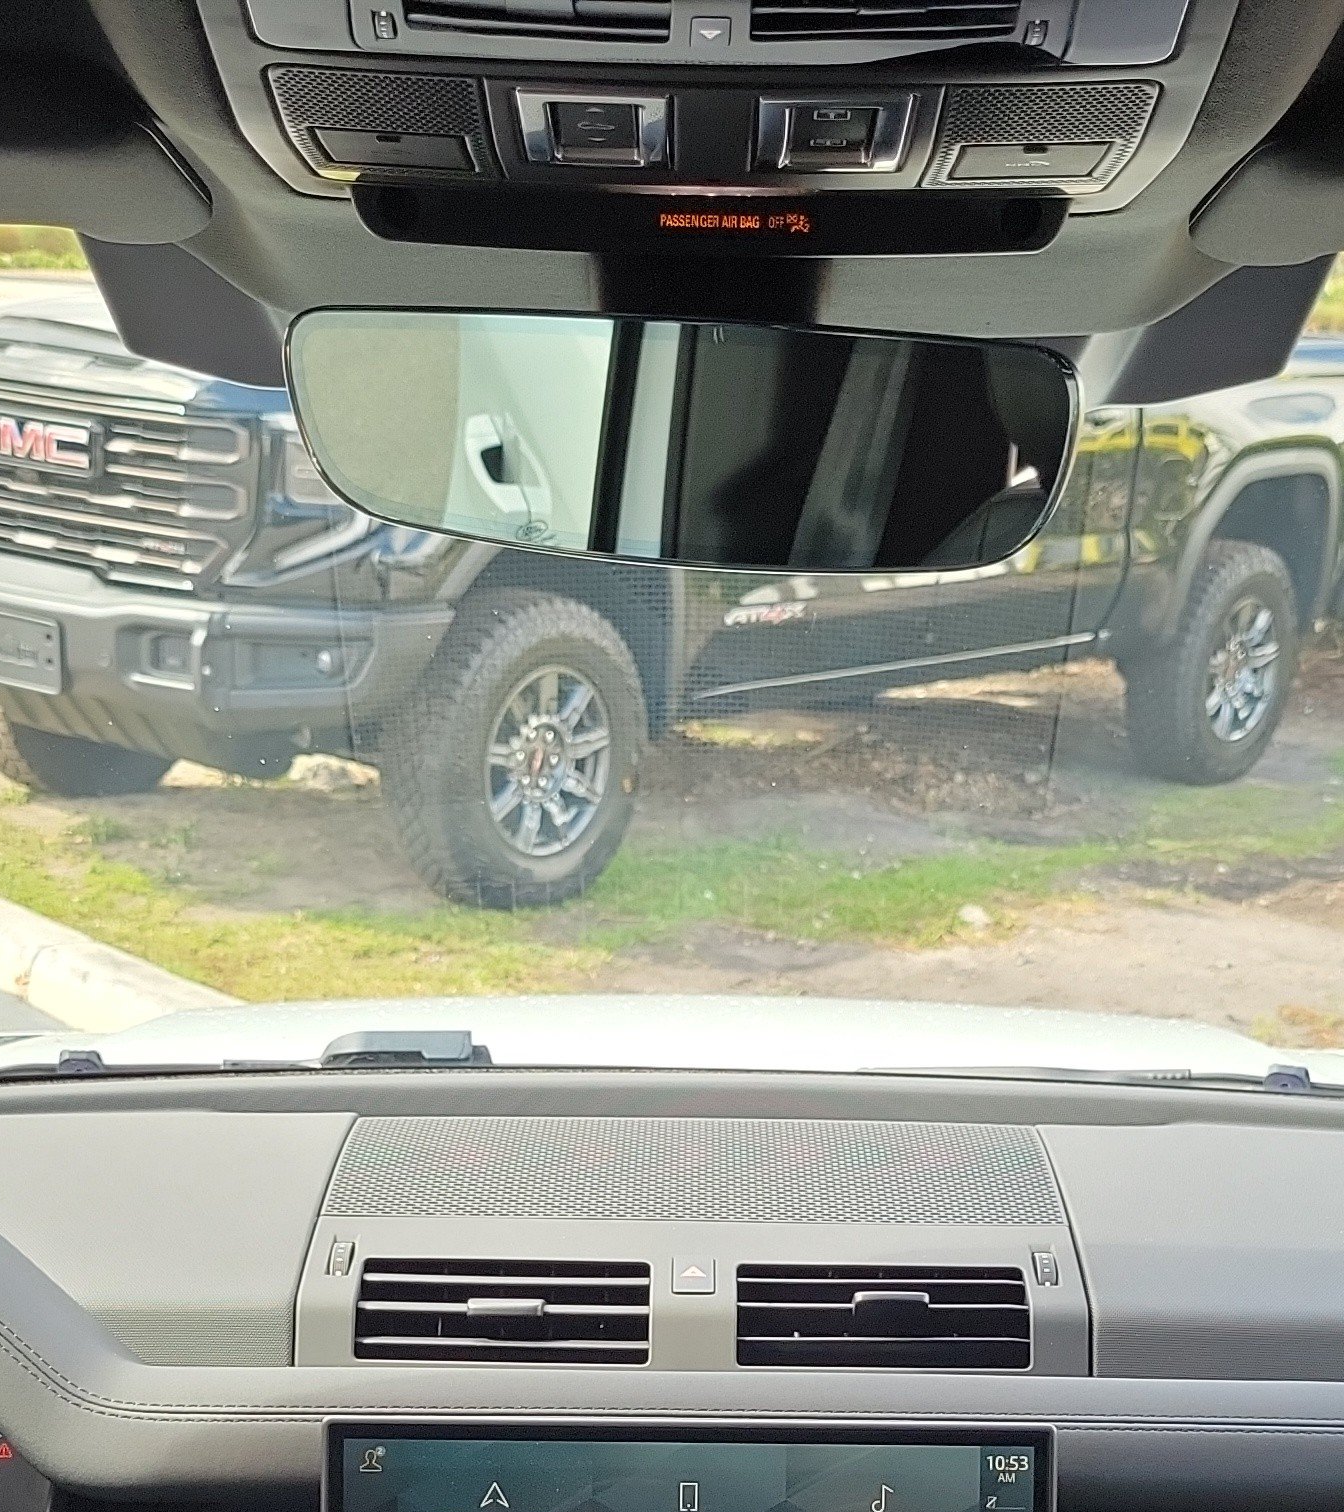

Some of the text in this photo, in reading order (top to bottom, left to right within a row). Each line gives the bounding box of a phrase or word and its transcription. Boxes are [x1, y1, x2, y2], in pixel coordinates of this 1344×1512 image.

[660, 214, 719, 228] PASSENGER
[722, 216, 738, 228] AIR
[740, 216, 760, 229] BAG
[987, 1456, 1029, 1471] 10:53
[998, 1473, 1016, 1483] AM
